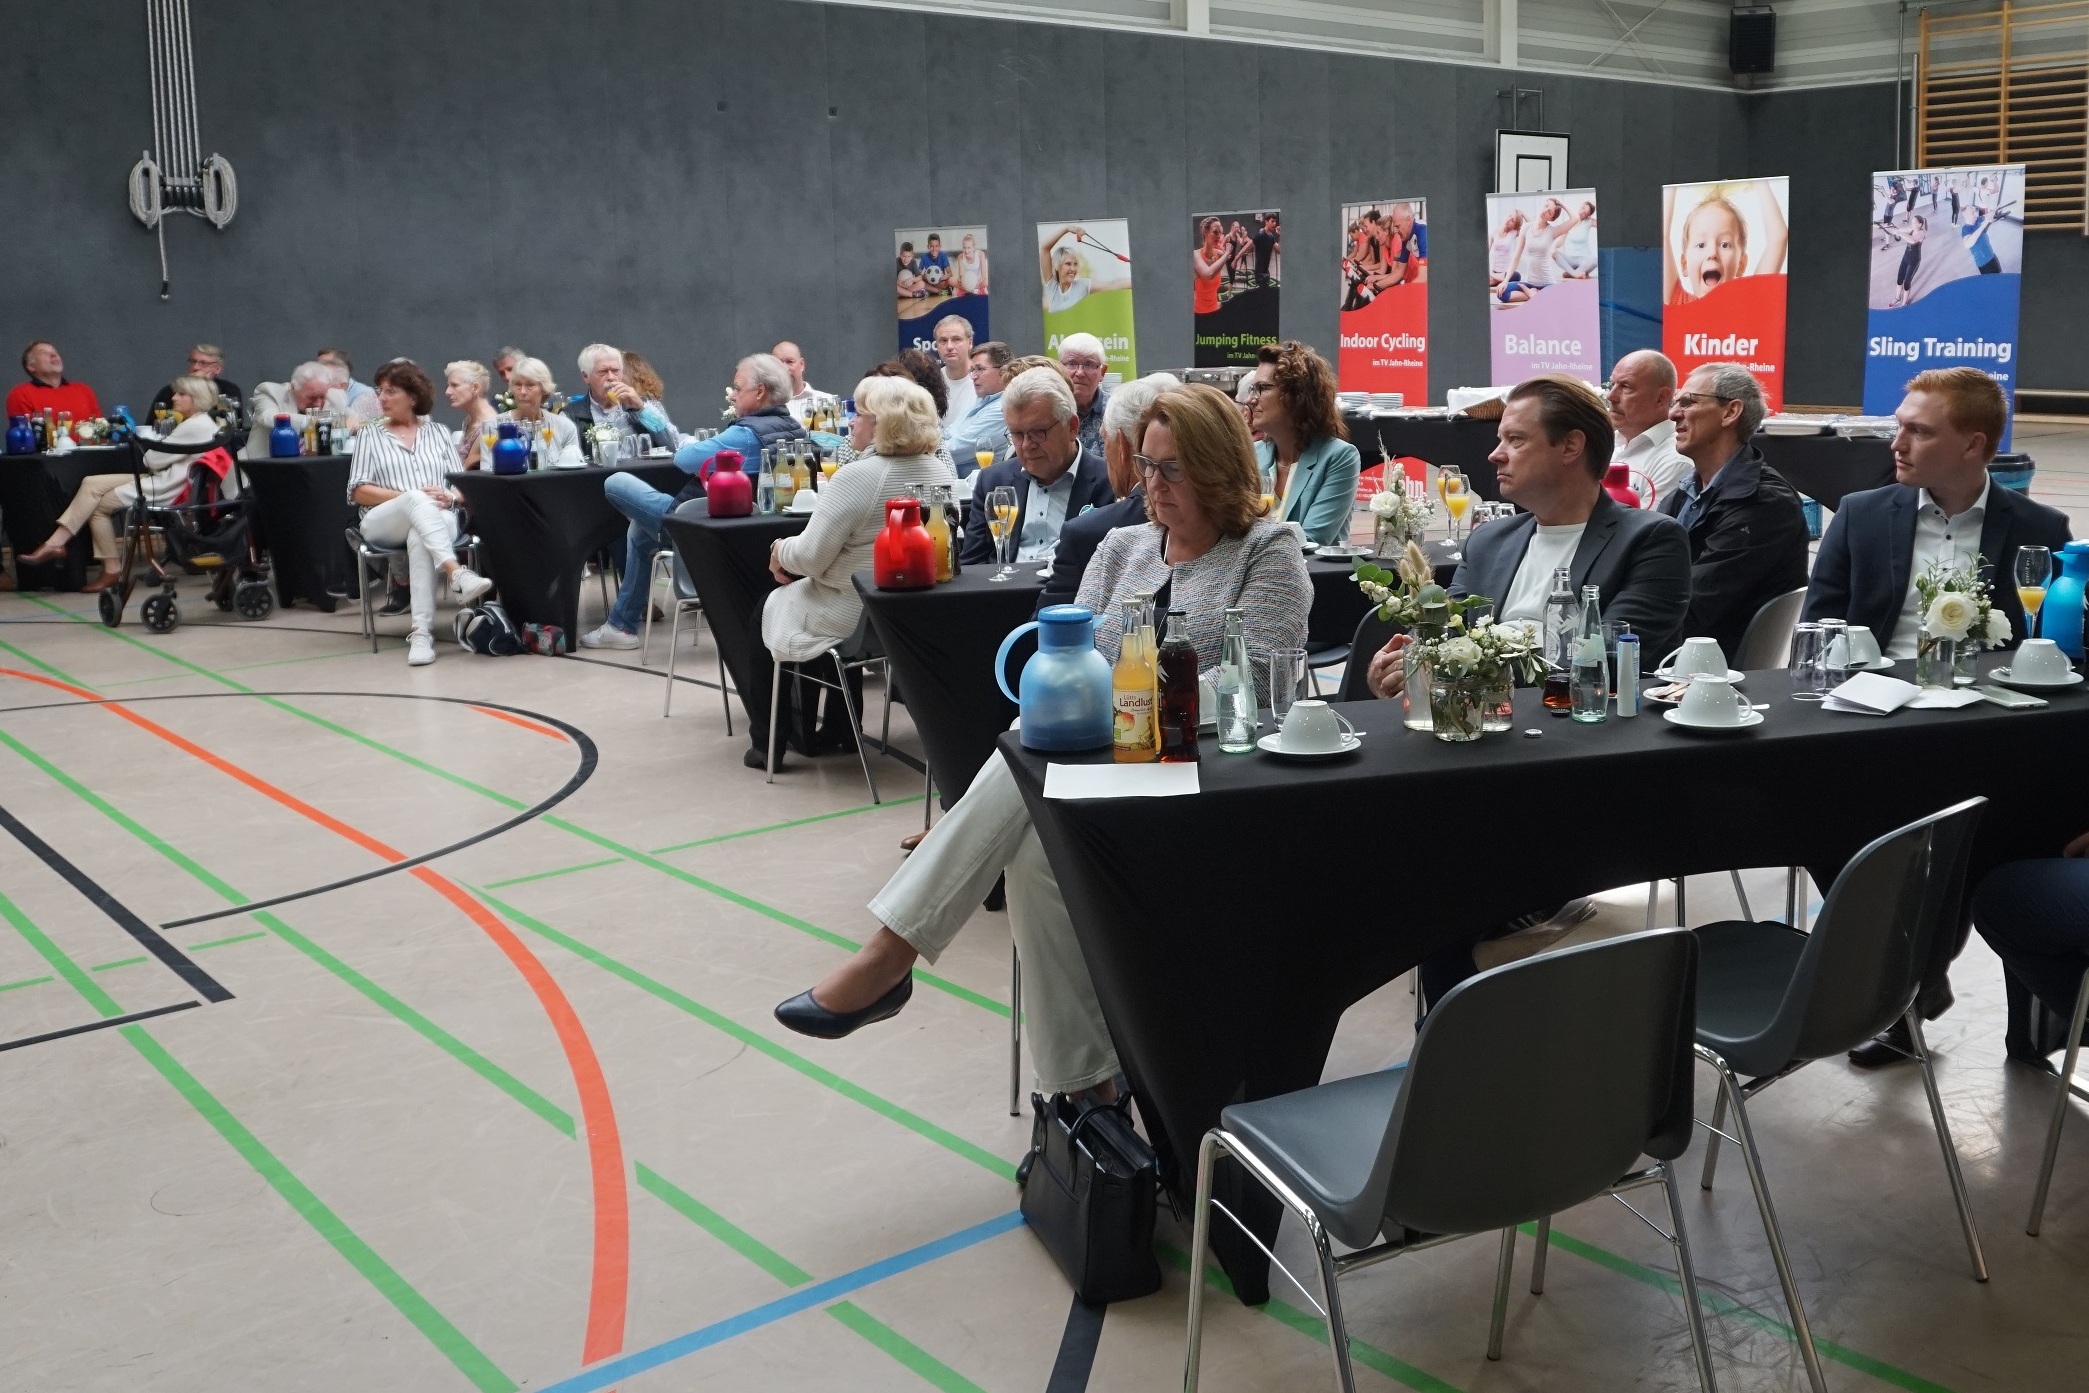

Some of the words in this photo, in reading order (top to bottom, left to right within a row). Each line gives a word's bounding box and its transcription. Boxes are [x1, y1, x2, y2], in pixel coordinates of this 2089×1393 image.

[1195, 333, 1238, 348] Jumping
[1240, 332, 1277, 345] Fitness
[1340, 333, 1379, 348] Indoor
[1381, 333, 1426, 352] Cycling
[1505, 333, 1582, 356] Balance
[1684, 333, 1759, 356] Kinder
[1869, 336, 1920, 362] Sling
[1924, 337, 2012, 362] Training
[1372, 358, 1380, 366] im
[1380, 358, 1389, 366] TV
[1389, 358, 1424, 367] Jahn-Rheine
[1531, 361, 1541, 369] im
[1541, 361, 1551, 370] TV
[1551, 361, 1593, 371] Jahn-Rheine
[1119, 697, 1153, 707] Landlust
